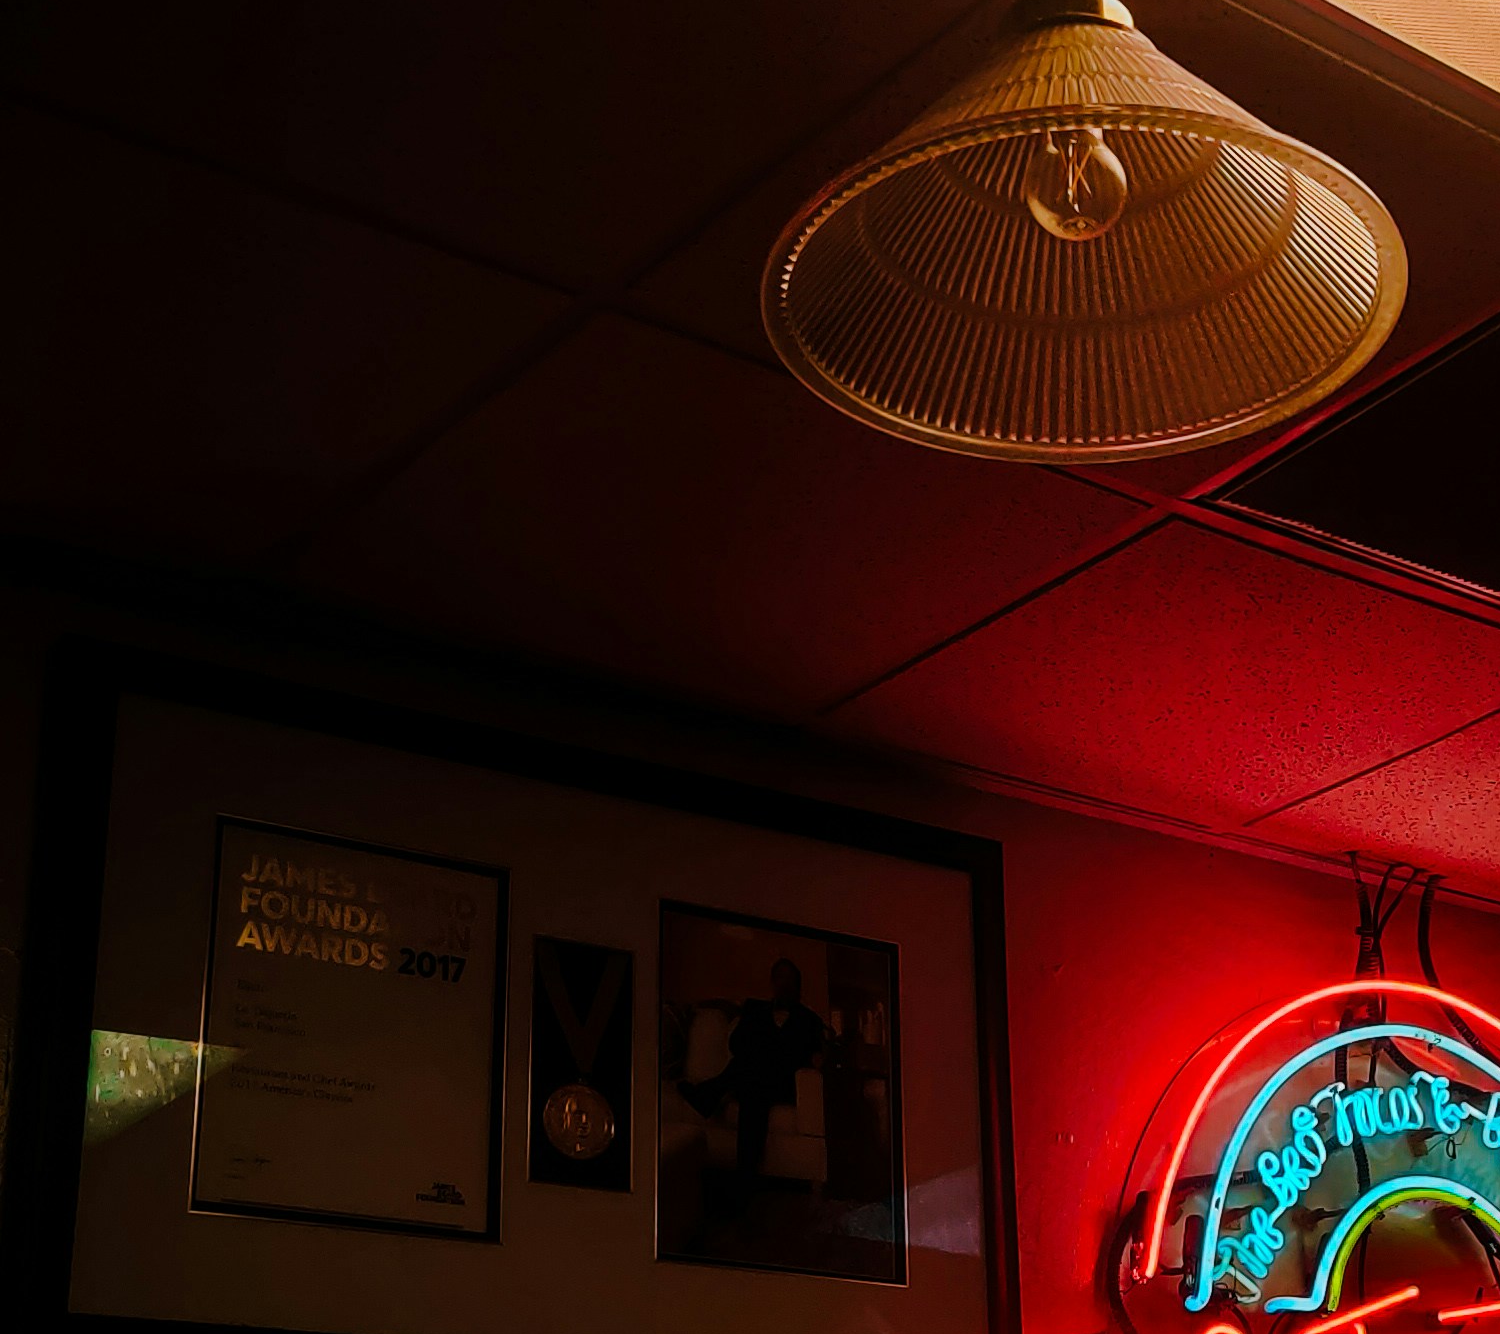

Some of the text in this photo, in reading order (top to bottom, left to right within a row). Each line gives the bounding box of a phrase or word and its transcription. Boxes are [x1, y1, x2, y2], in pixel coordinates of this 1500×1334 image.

[241, 854, 357, 899] JAMES
[236, 920, 466, 983] AWARDS 2017
